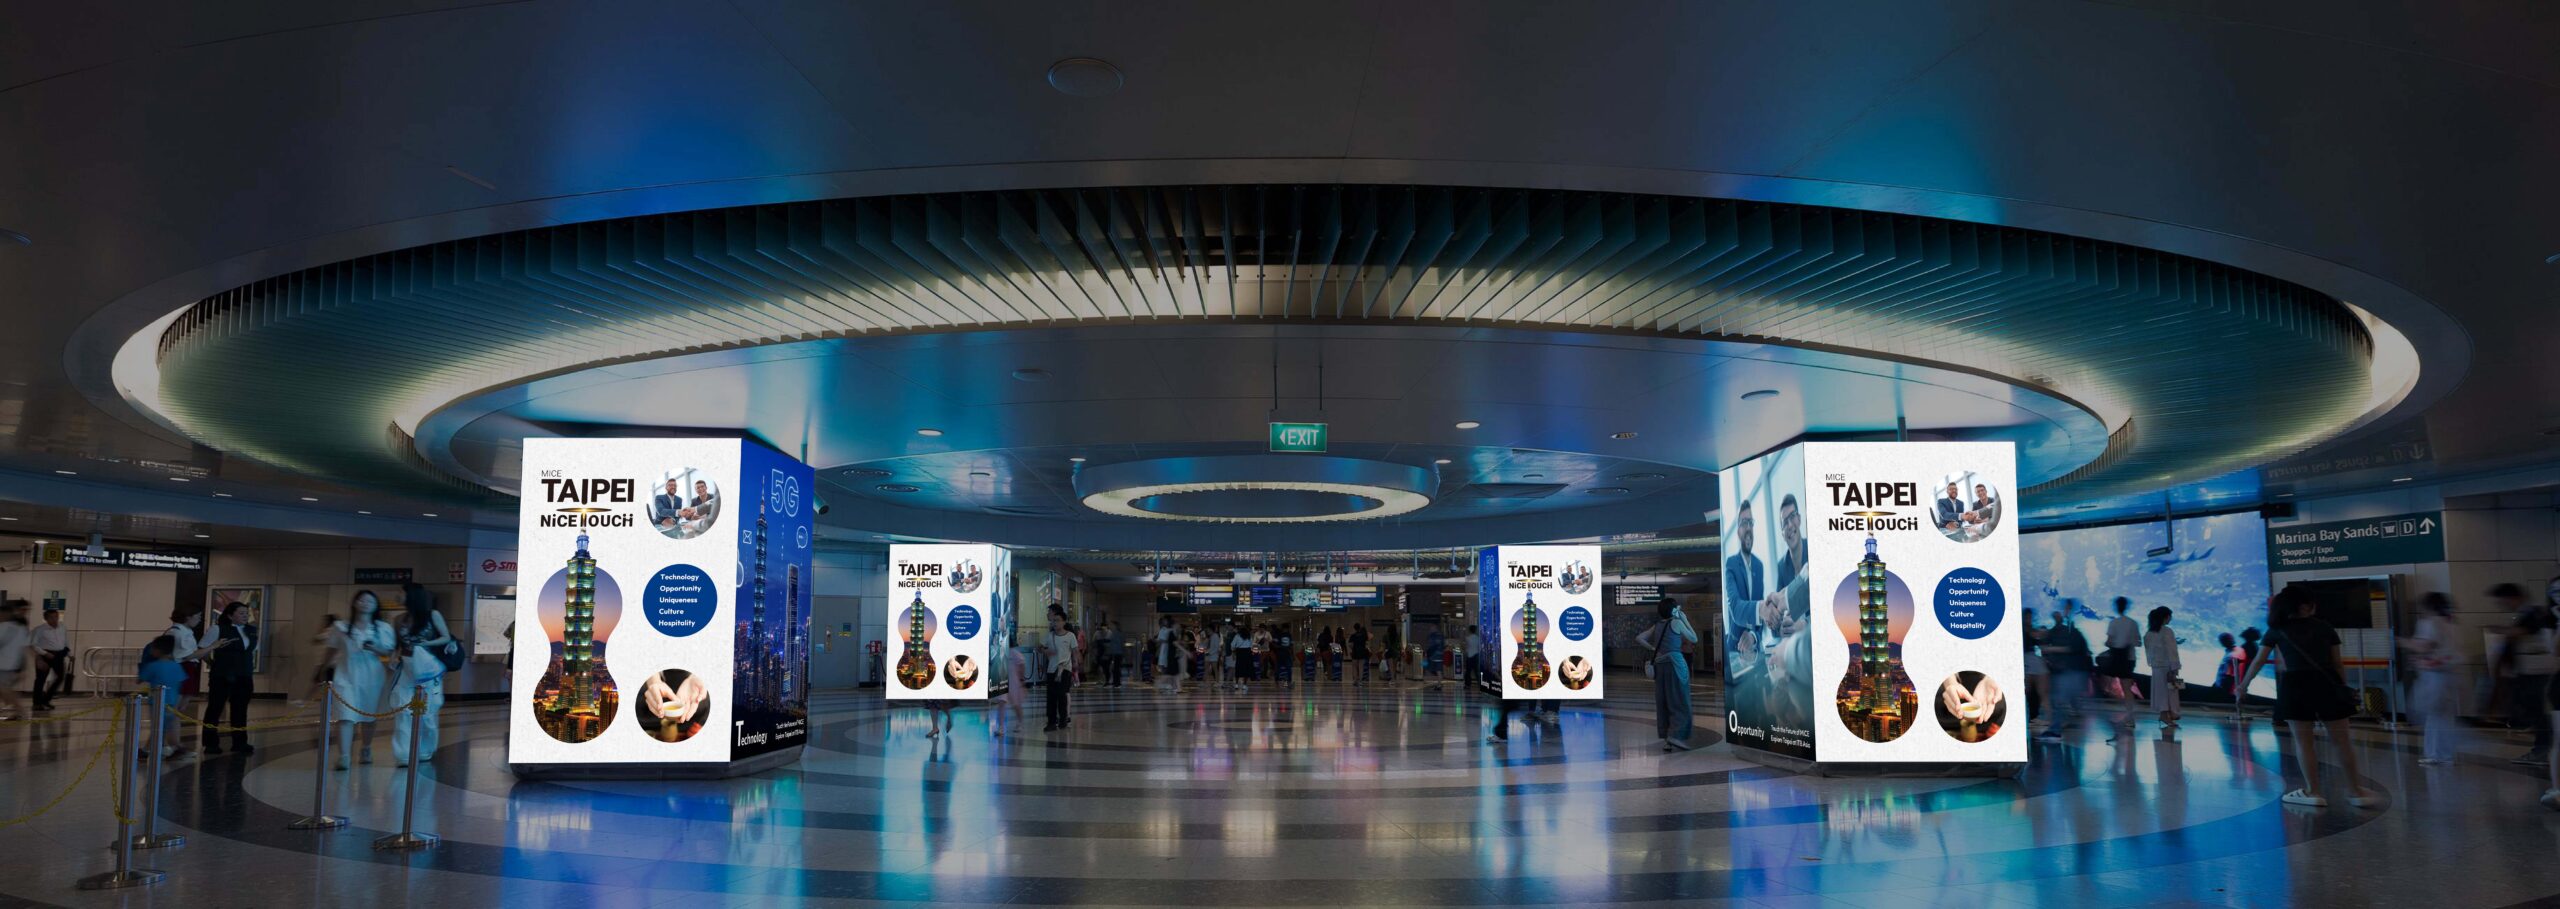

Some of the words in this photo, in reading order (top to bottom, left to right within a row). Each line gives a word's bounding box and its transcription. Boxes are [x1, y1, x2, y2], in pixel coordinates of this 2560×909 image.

[1288, 428, 1319, 446] EXIT
[541, 470, 562, 478] MICE
[541, 479, 634, 505] TAIPEI
[771, 468, 799, 517] 5G
[1826, 482, 1917, 508] TAIPEI
[2275, 531, 2316, 544] Marina
[2320, 530, 2341, 542] Bay
[2343, 524, 2380, 539] Sands
[2403, 522, 2413, 534] D
[50, 550, 57, 558] B
[2281, 548, 2311, 556] Shoppes
[660, 574, 700, 582] Technology
[898, 564, 942, 577] TAIPEI
[1508, 565, 1552, 578] TAIPEI
[736, 720, 768, 747] Technology
[1729, 710, 1765, 741] Opportunity
